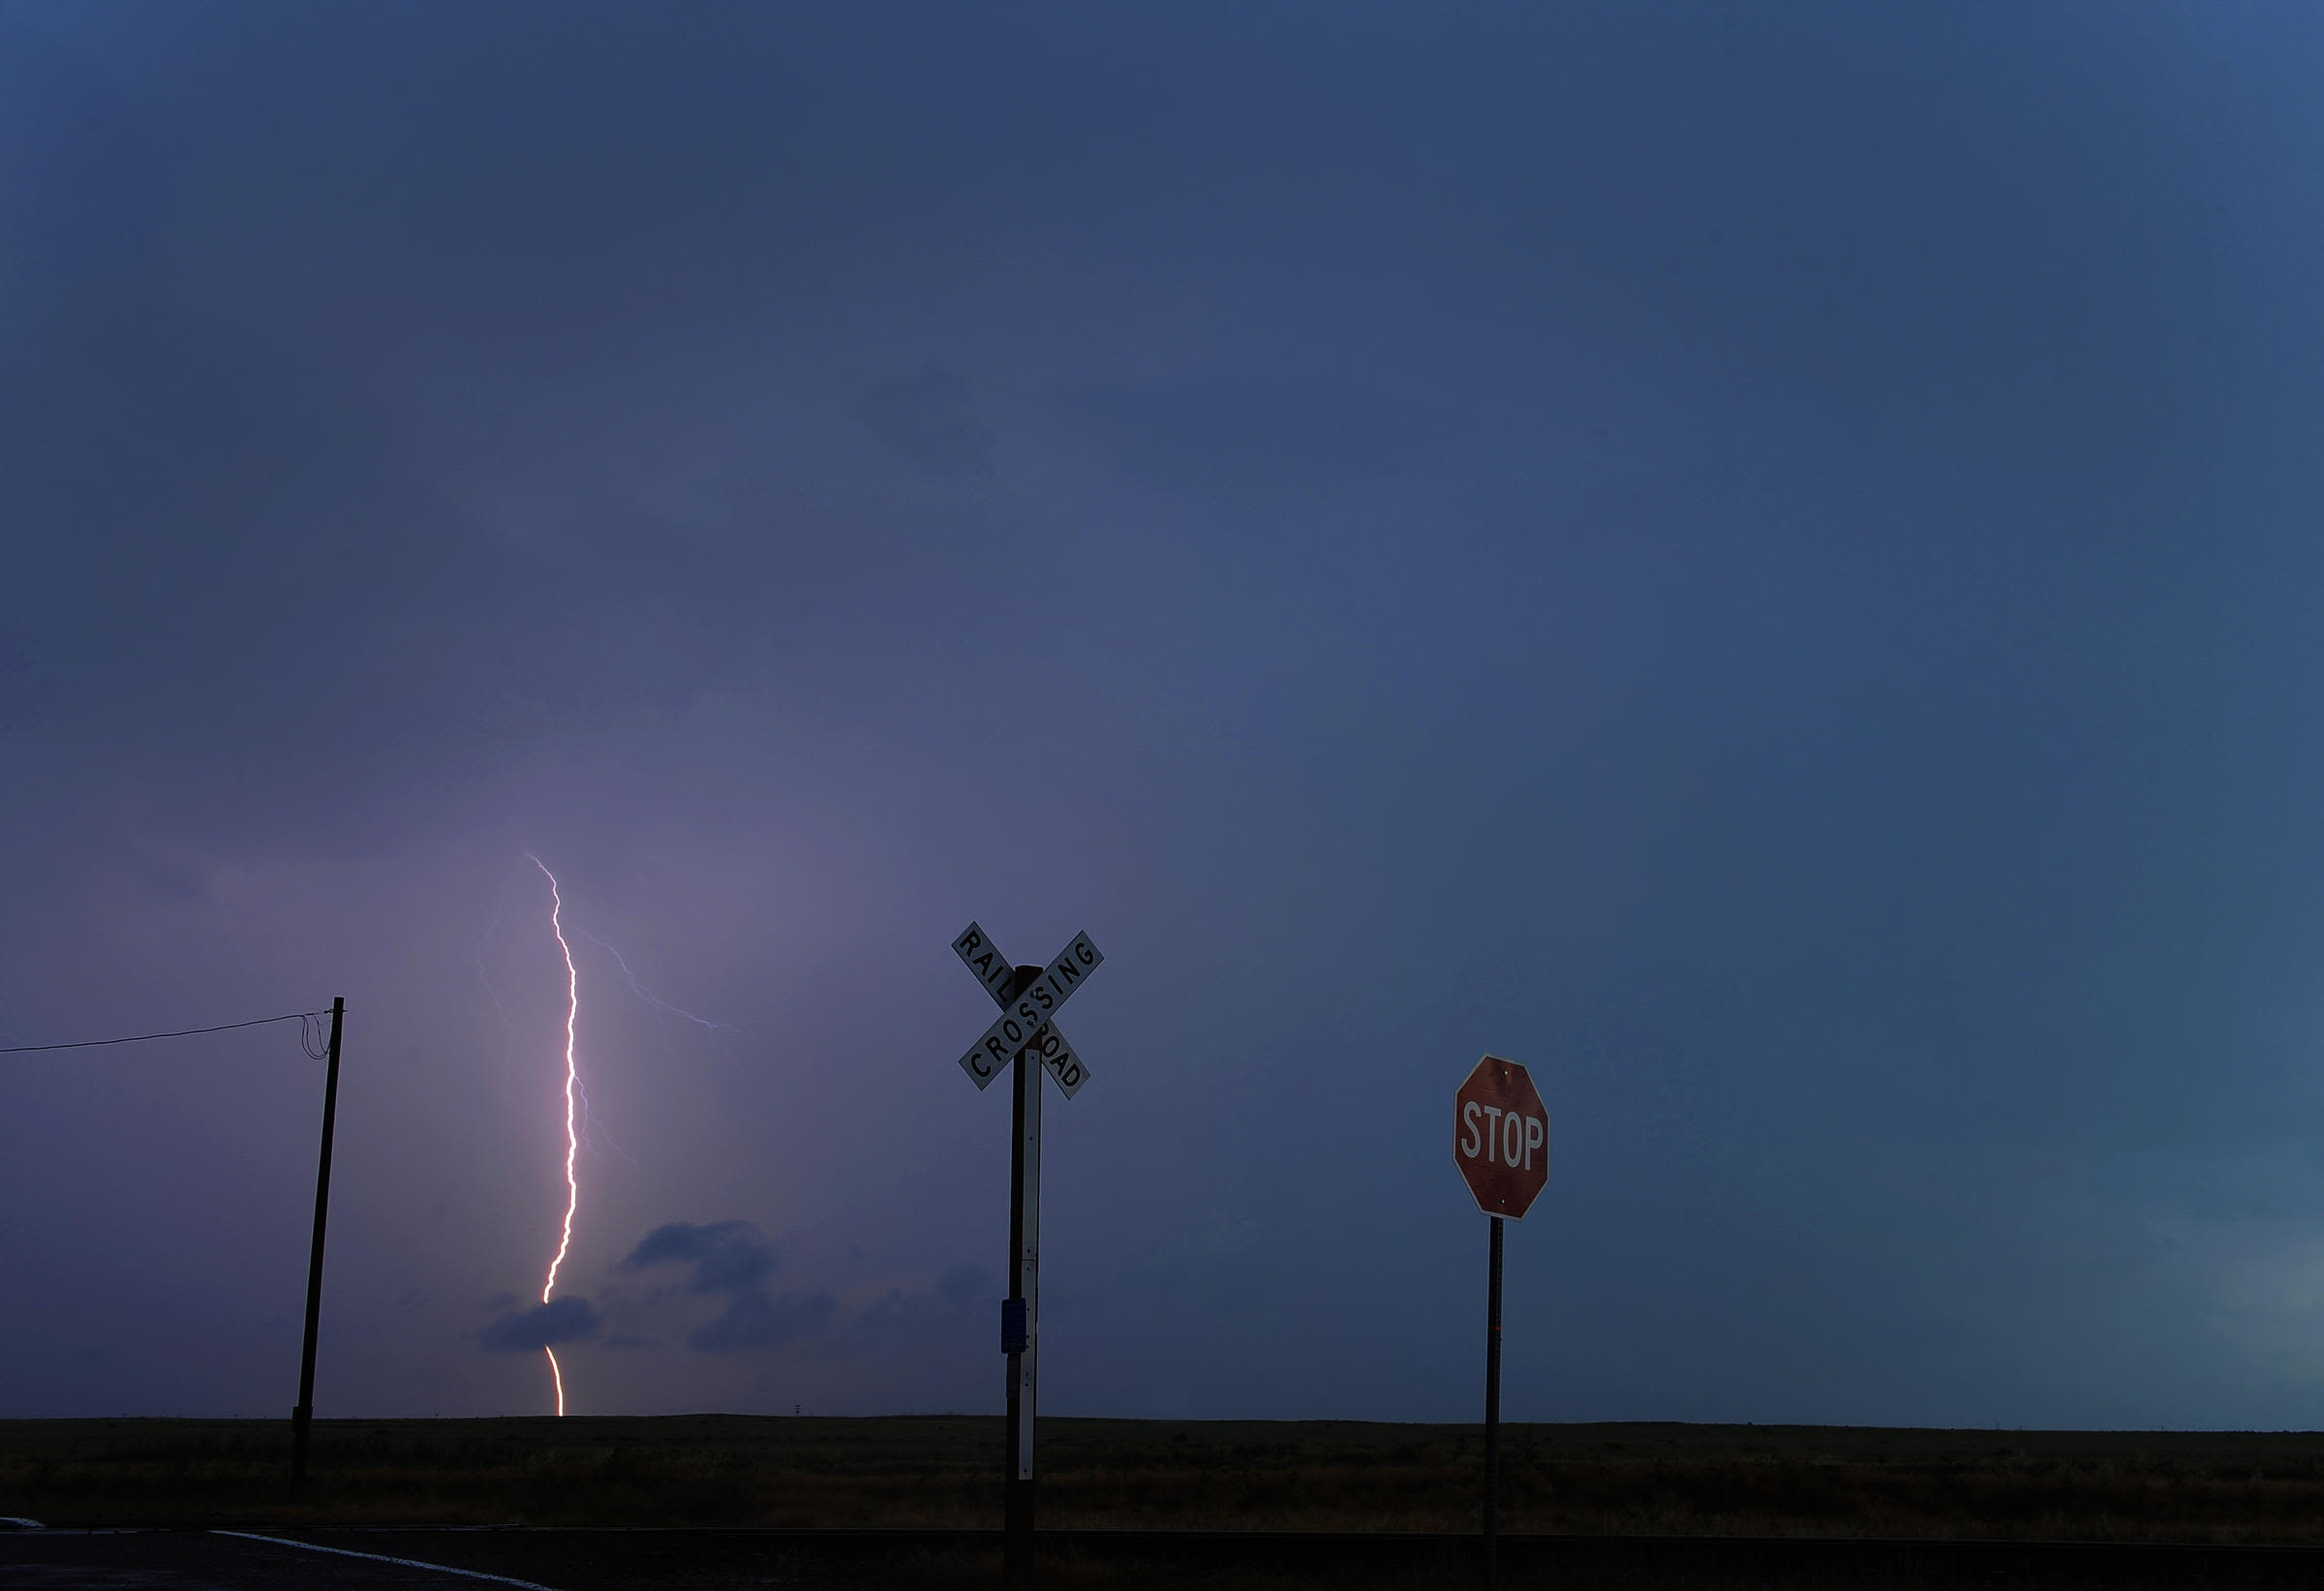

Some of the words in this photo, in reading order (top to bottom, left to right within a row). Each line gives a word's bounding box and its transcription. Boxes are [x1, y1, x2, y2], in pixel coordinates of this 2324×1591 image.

[960, 930, 1014, 1003] RAIL
[970, 942, 1094, 1078] CROSSING
[1461, 1100, 1544, 1171] STOP
